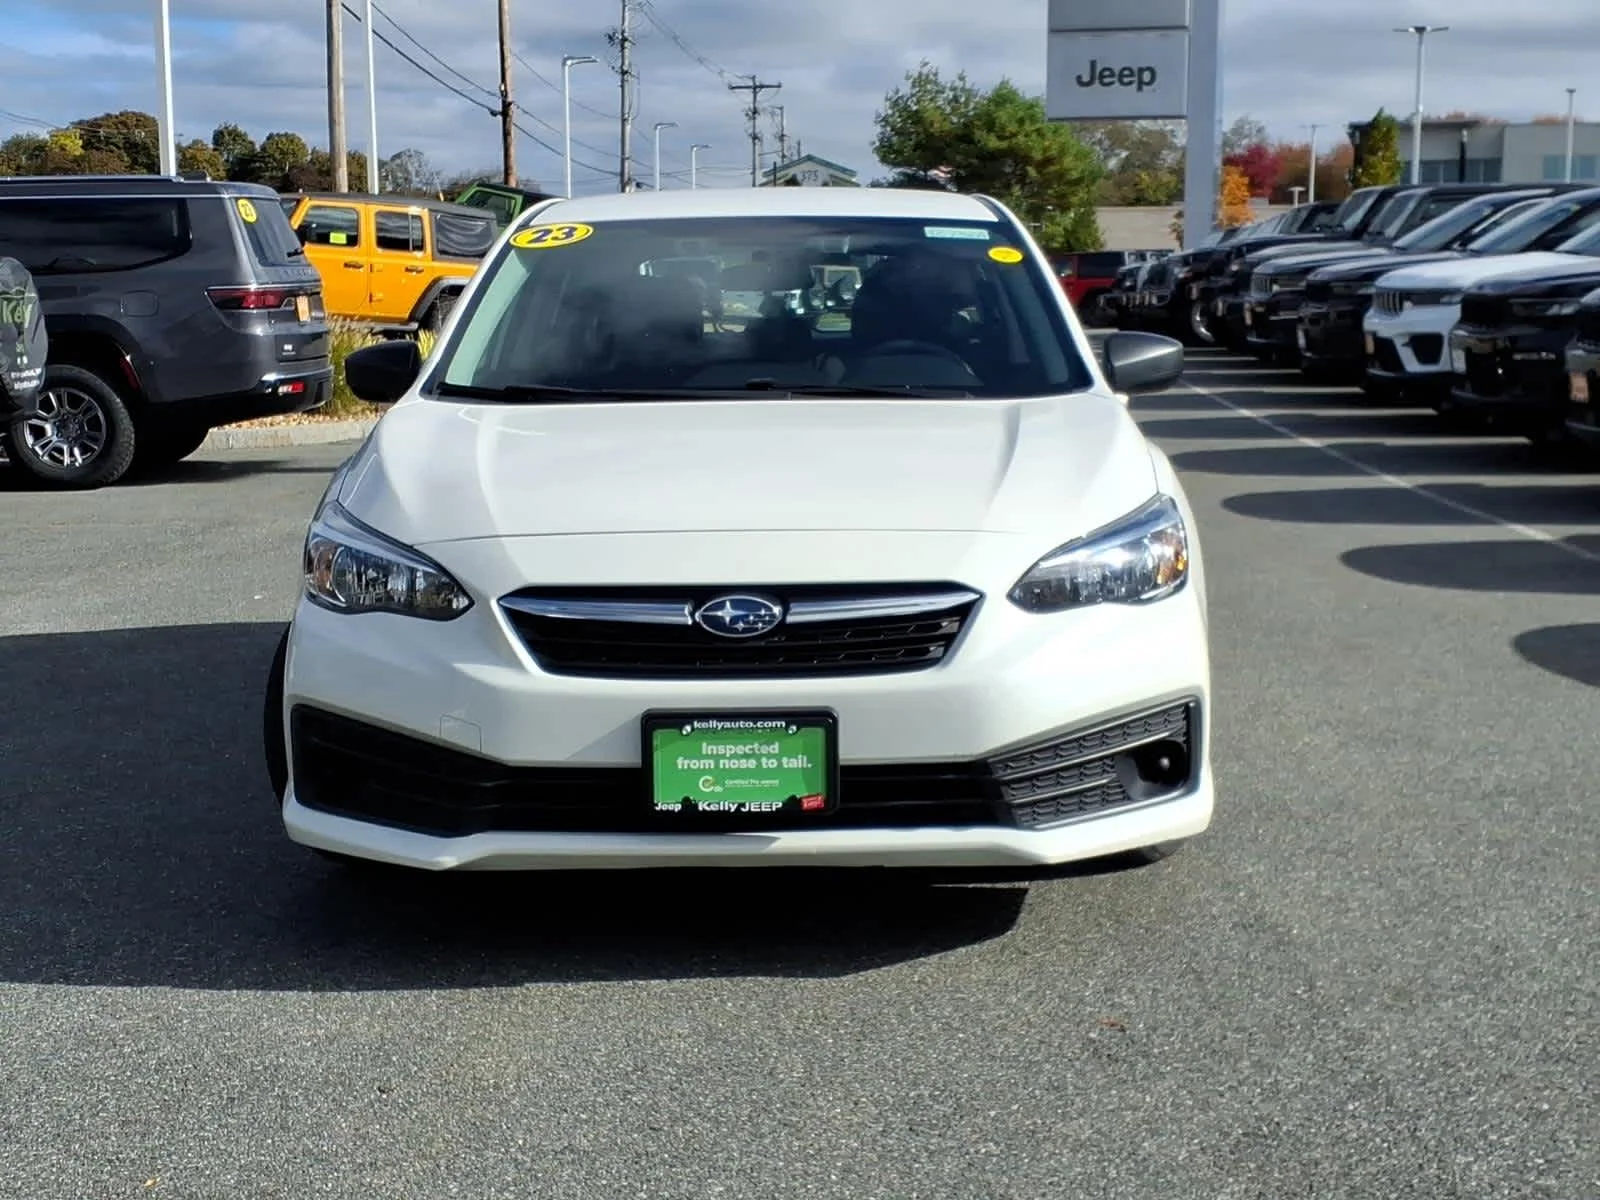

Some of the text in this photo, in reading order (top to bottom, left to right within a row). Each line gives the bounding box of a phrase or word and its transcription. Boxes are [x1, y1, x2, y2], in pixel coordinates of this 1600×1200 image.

[1075, 59, 1157, 92] Jeep
[526, 226, 578, 243] 23
[693, 719, 786, 730] kellyauto.com
[702, 741, 779, 757] Inspected
[676, 755, 812, 769] from nose to tail.
[655, 802, 683, 812] Jeep
[698, 801, 783, 812] Kelly JEEP
